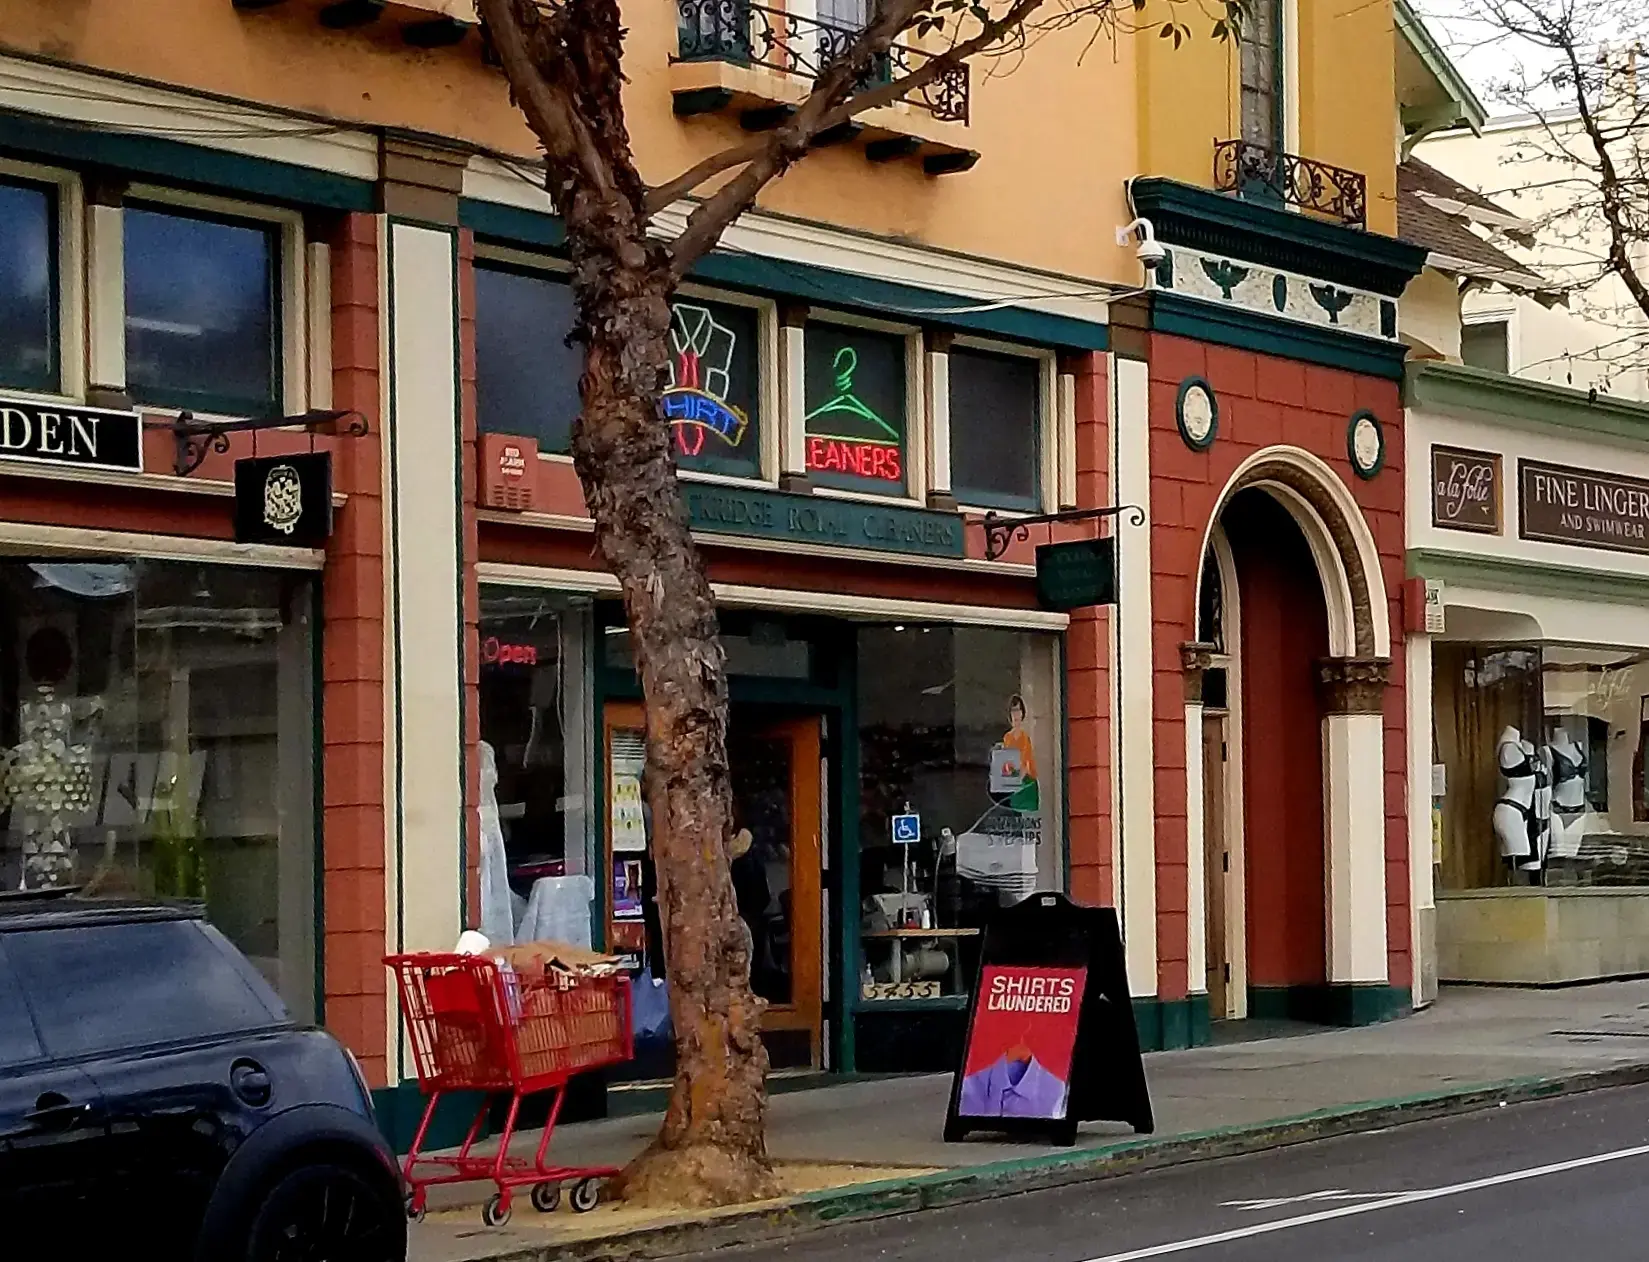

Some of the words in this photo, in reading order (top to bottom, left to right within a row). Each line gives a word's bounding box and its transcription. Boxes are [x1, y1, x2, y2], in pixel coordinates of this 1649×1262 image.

[662, 395, 736, 434] HIRT
[805, 438, 901, 480] EANERS
[1534, 475, 1579, 508] FINE
[863, 514, 954, 547] CLEANERS
[1561, 513, 1583, 531] AND
[1585, 517, 1646, 541] SWIMWEAR
[482, 636, 537, 666] Open
[991, 975, 1075, 996] SHIRTS
[988, 993, 1071, 1013] LAUNDERED
